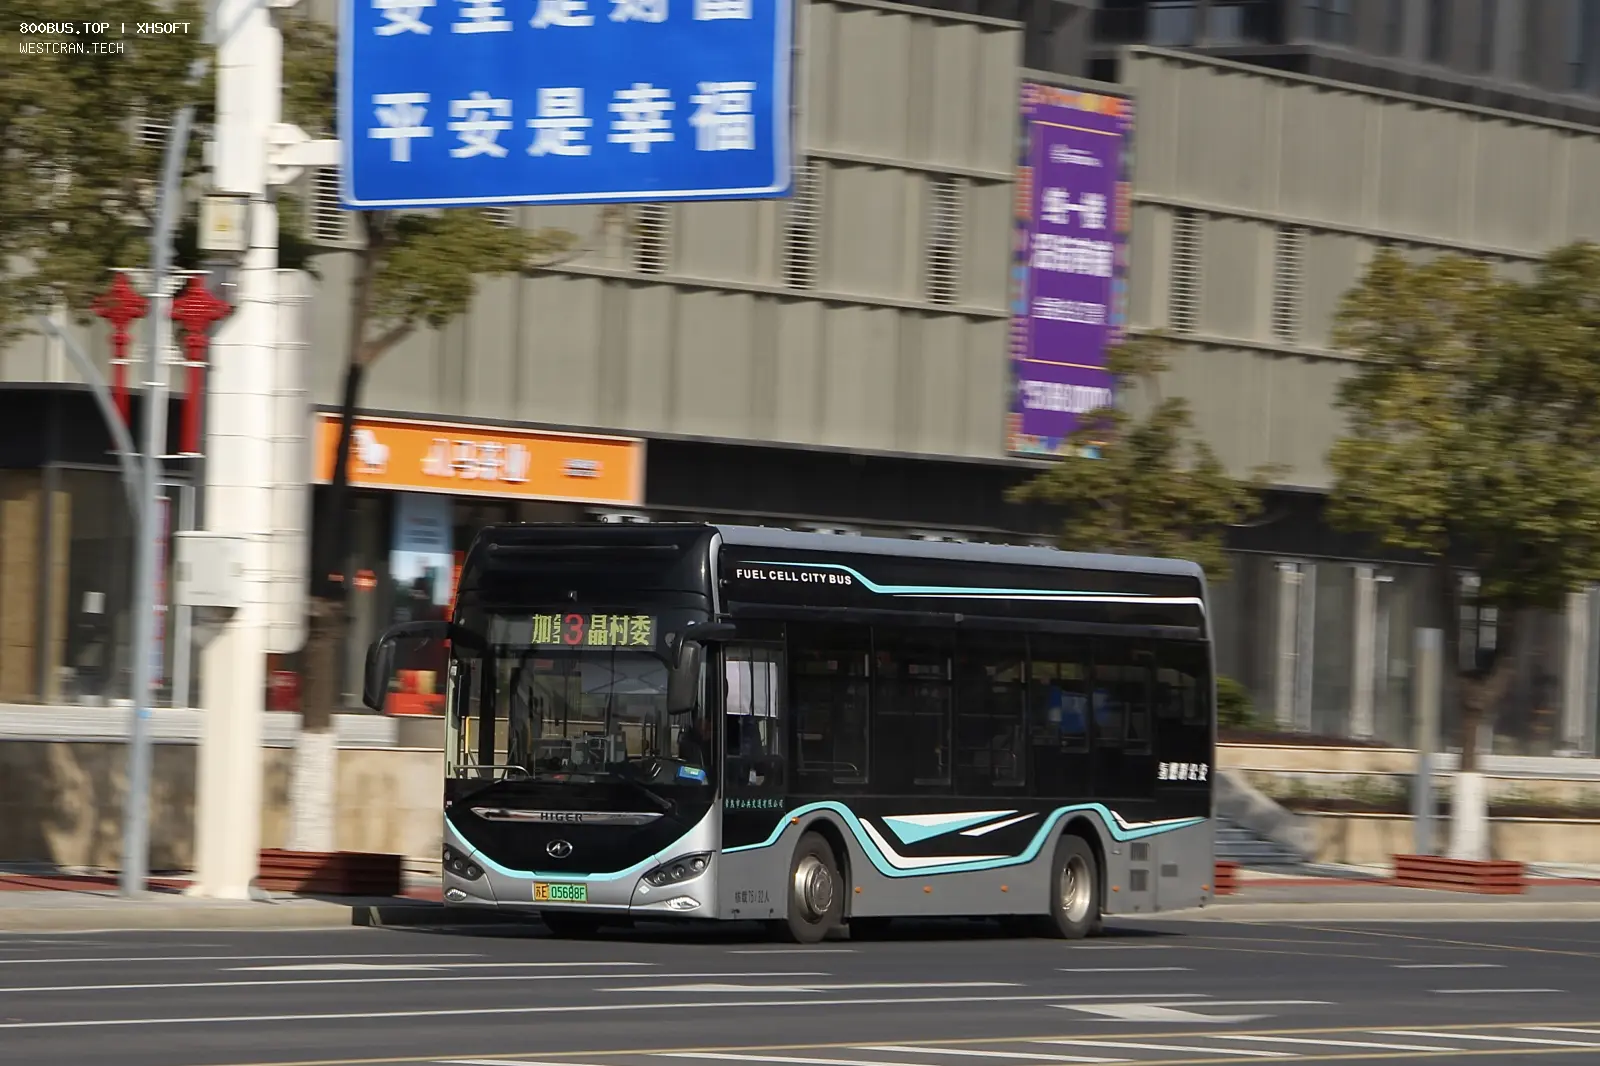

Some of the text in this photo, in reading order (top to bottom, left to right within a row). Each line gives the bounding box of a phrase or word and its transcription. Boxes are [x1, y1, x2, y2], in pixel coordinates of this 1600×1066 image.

[367, 81, 757, 163] 平安是幸福
[736, 569, 852, 585] FUEL CELL CITY BUS
[563, 613, 584, 646] 3
[588, 614, 651, 646] 晶村委
[540, 811, 583, 822] HIGER
[551, 885, 585, 900] 05688F
